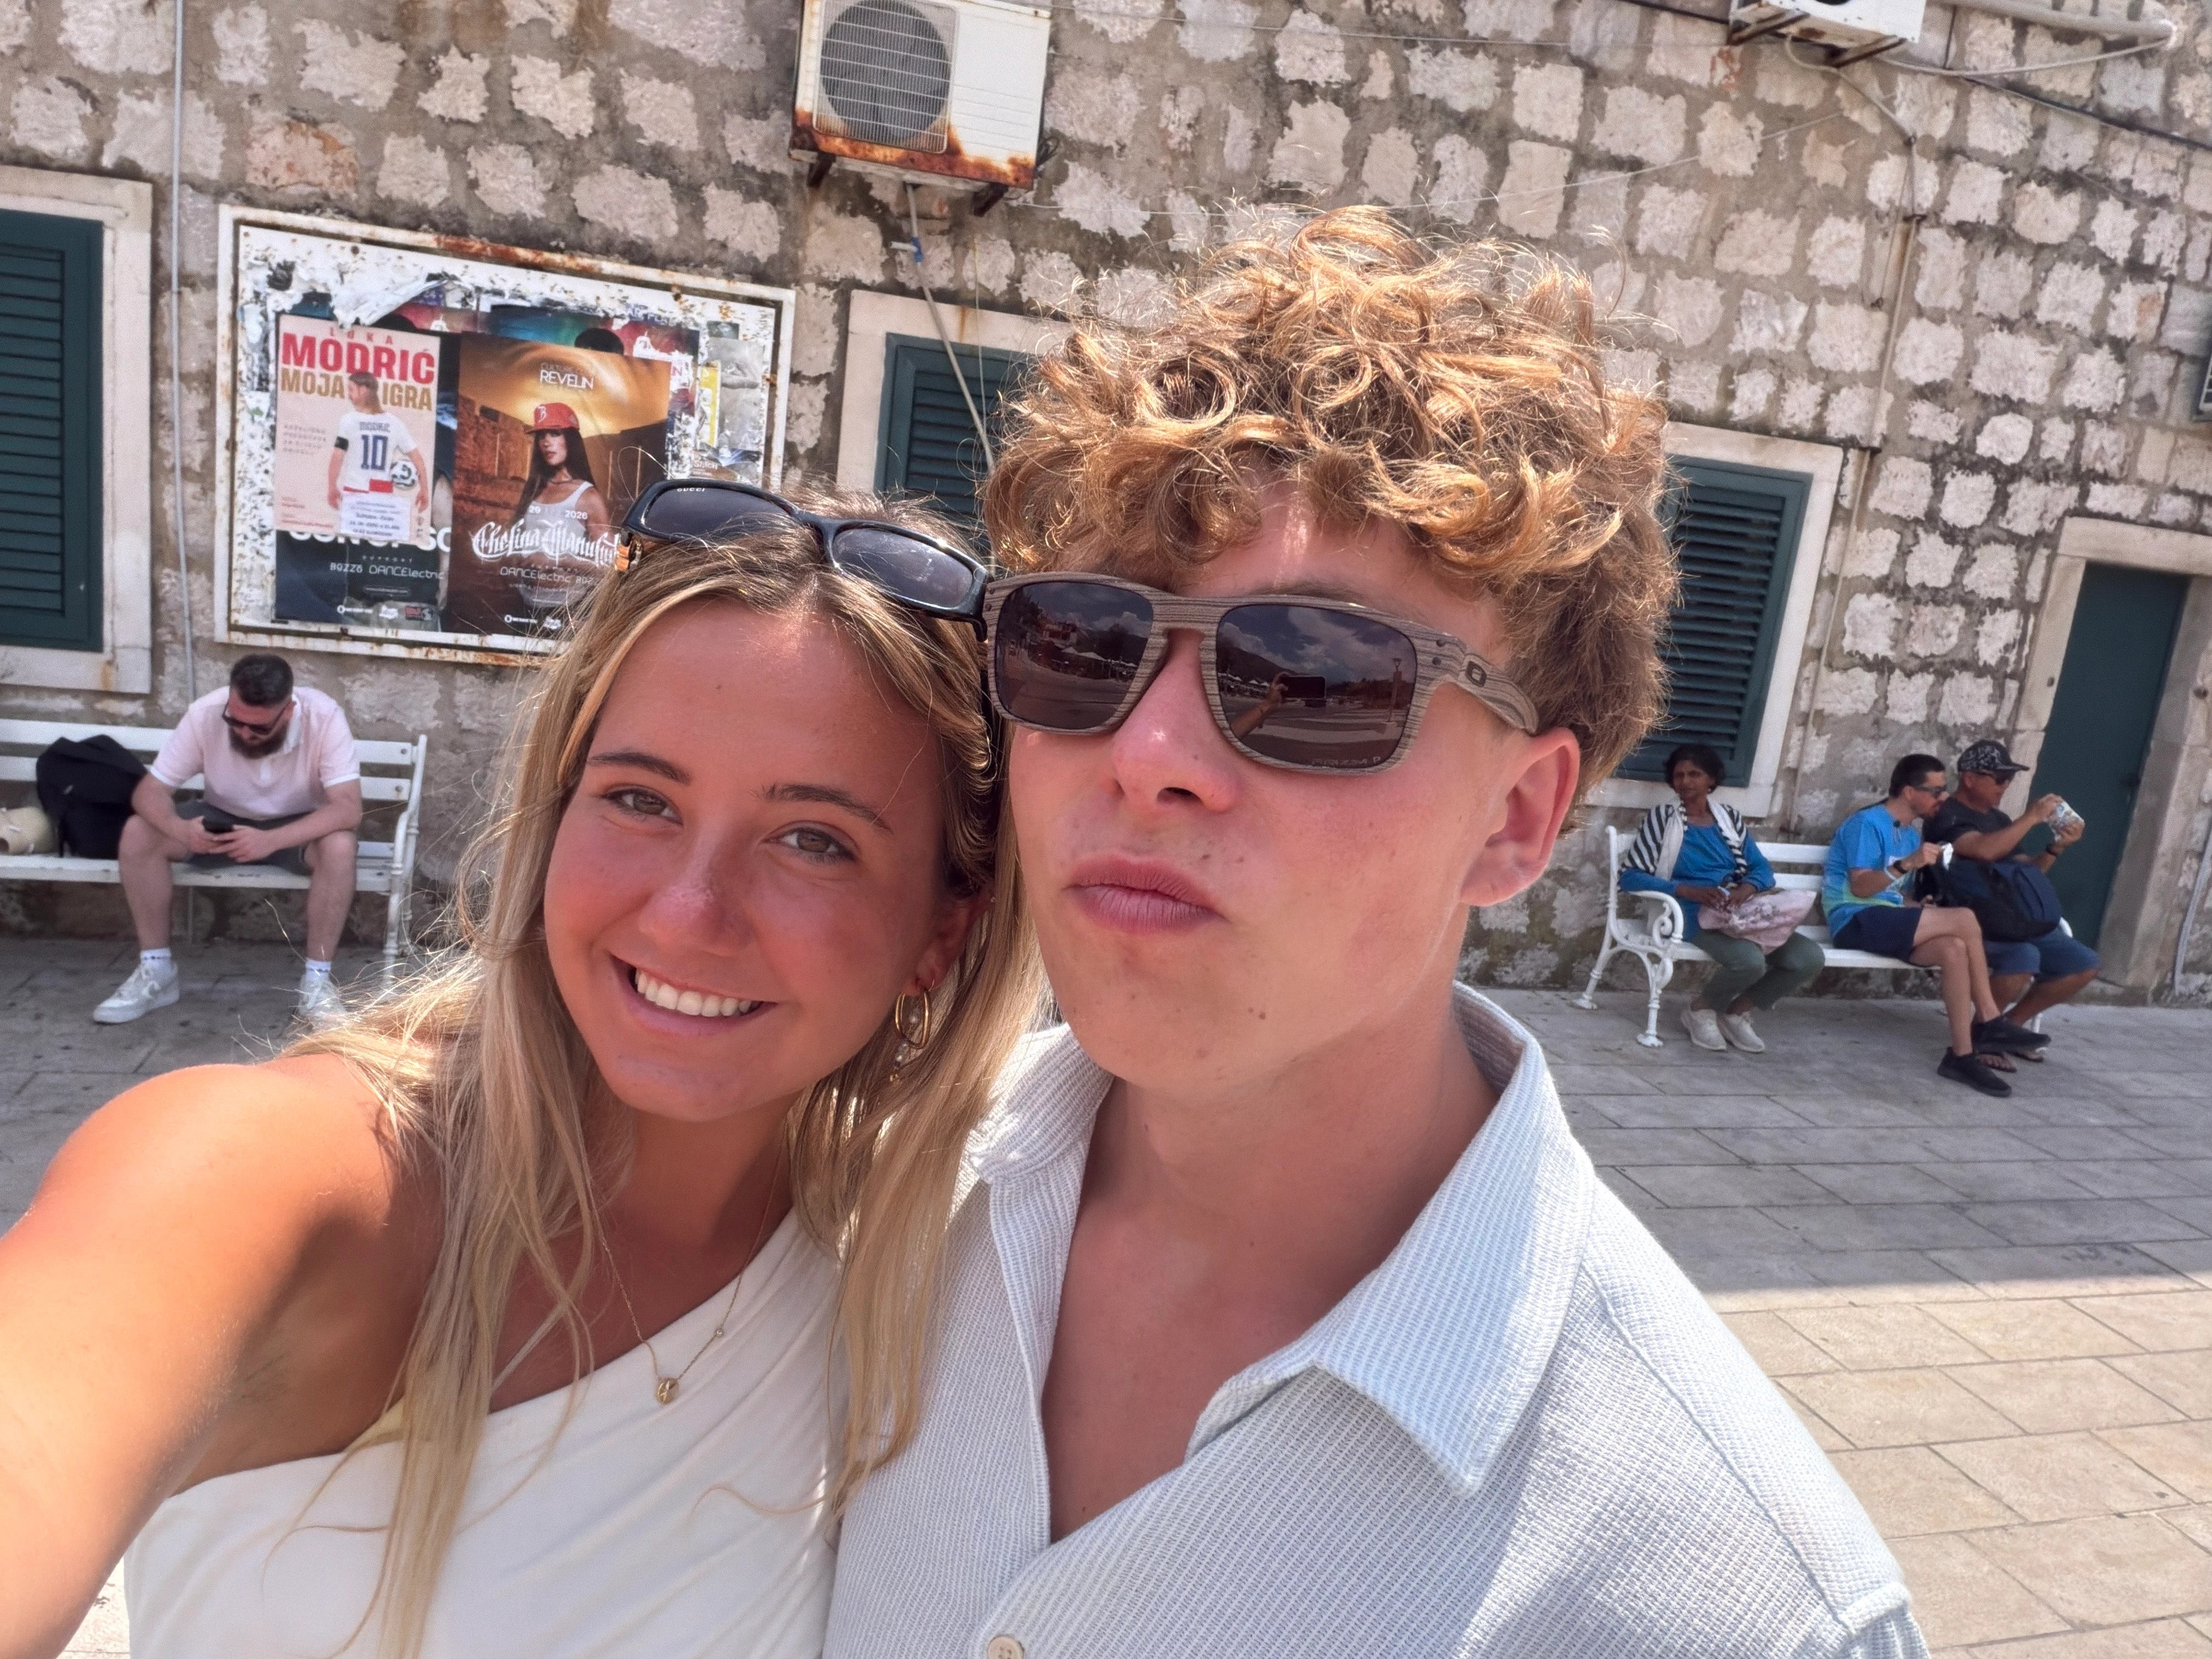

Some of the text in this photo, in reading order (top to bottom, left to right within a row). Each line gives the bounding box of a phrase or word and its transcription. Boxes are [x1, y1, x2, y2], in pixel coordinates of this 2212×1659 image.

[280, 367, 432, 411] MOJA IGRA
[540, 369, 594, 390] REVELIN
[361, 434, 388, 471] 10
[528, 505, 541, 514] 29
